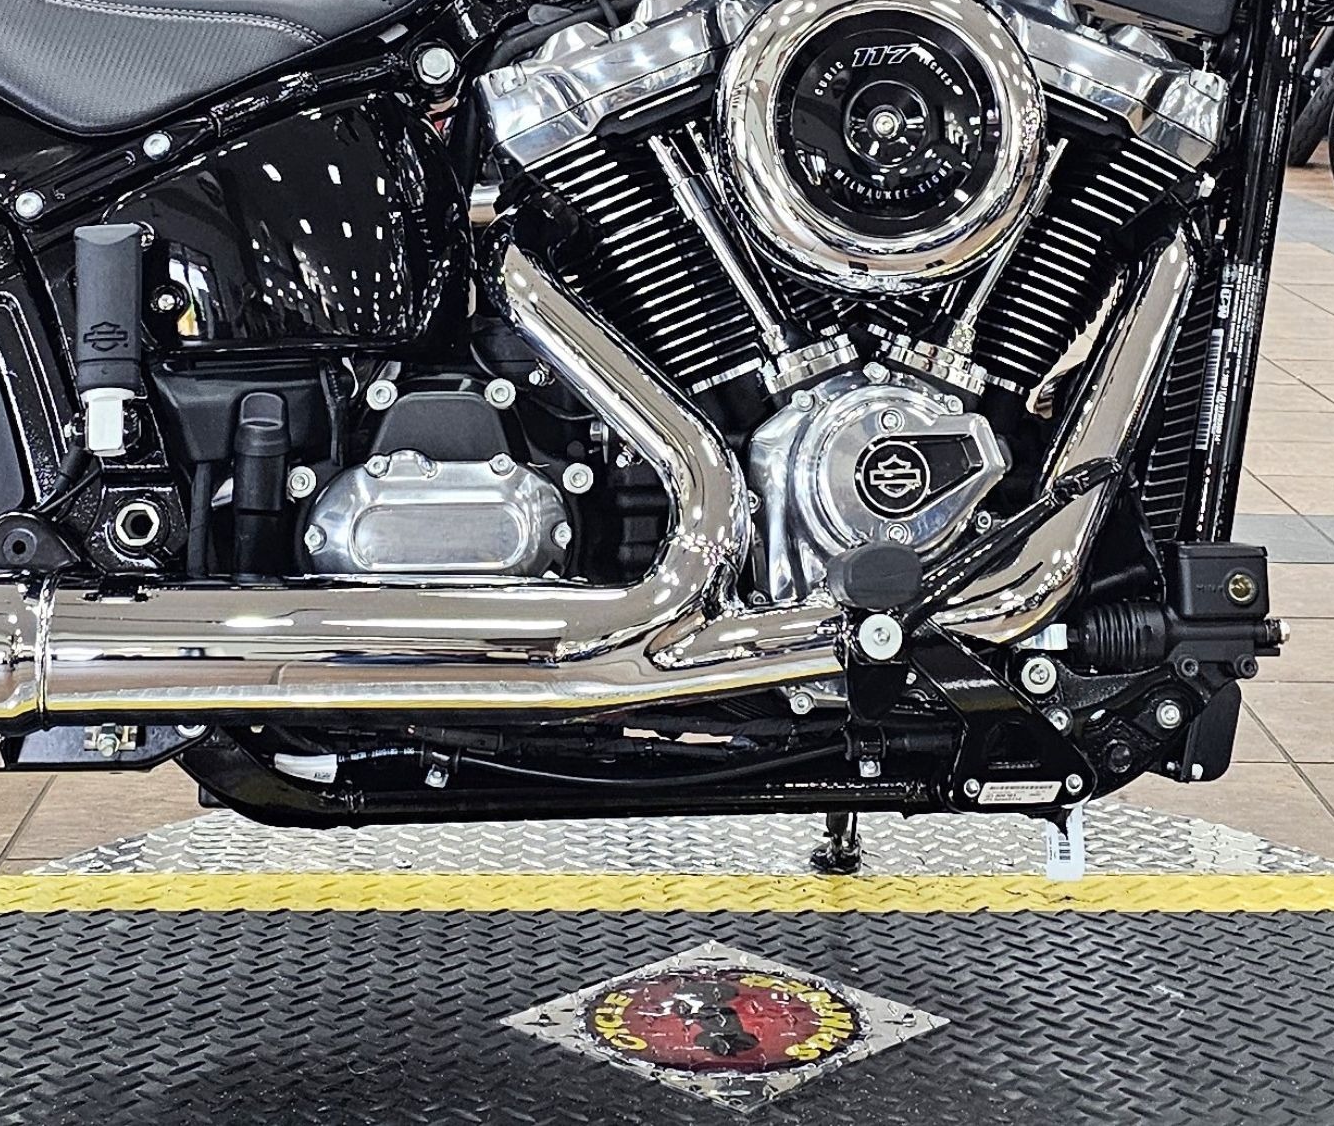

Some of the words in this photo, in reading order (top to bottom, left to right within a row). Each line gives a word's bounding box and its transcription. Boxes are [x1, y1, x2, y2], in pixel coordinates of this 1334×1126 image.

[814, 61, 844, 96] CUBIC
[852, 43, 920, 68] 117
[593, 991, 648, 1051] CYCLE
